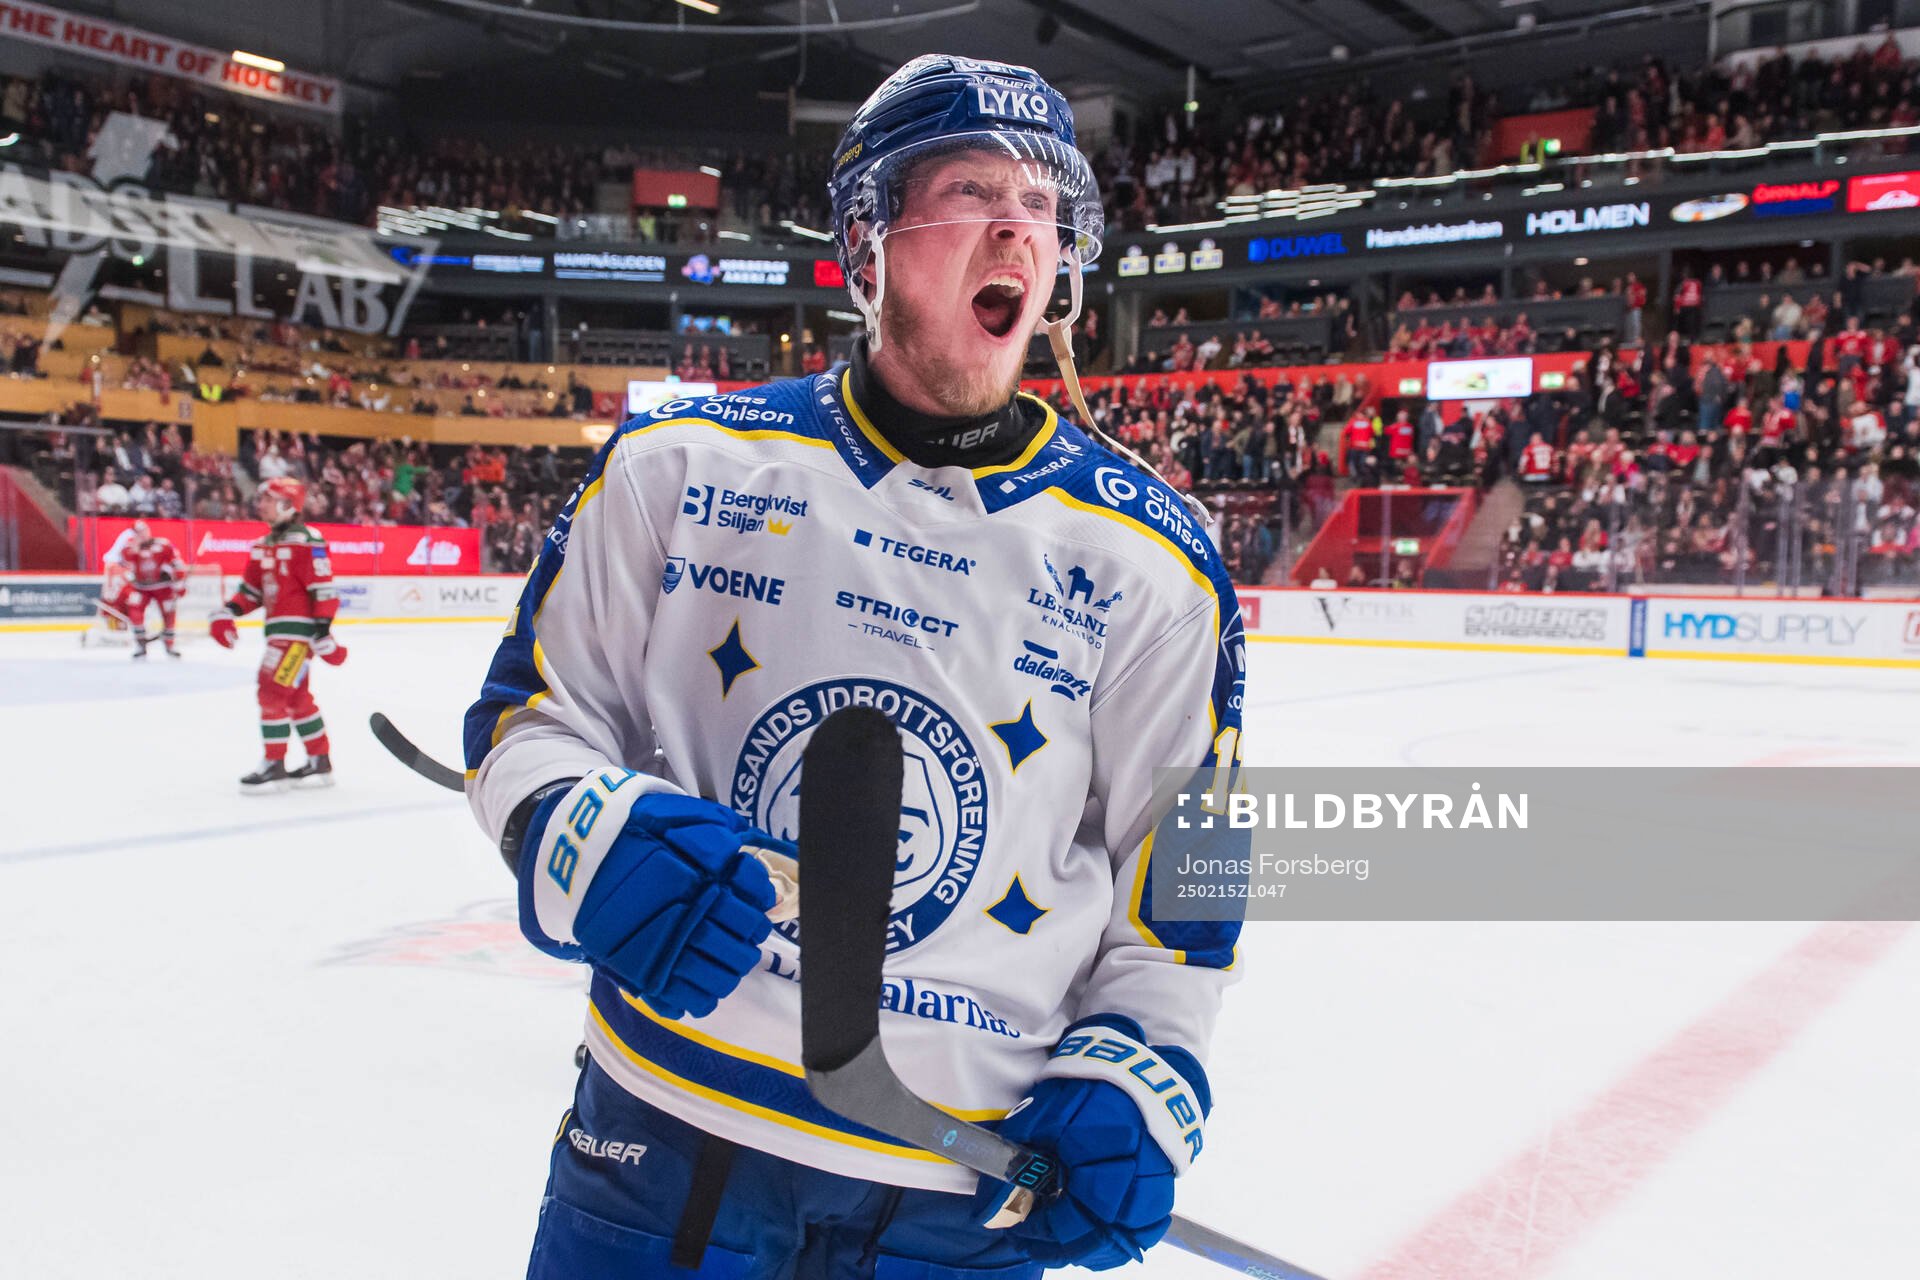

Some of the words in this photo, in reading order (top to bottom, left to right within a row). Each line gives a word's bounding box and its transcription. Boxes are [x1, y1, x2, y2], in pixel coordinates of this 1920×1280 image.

[0, 3, 57, 38] THE
[63, 19, 173, 66] HEART
[176, 50, 217, 77] OF
[221, 60, 335, 106] HOCKEY
[977, 87, 1049, 123] LYKO
[1526, 202, 1651, 237] HOLMEN
[700, 403, 795, 425] Ohlson
[829, 406, 869, 467] TEGERA
[1012, 455, 1074, 484] TEGERA
[720, 489, 808, 517] Bergkvist
[716, 510, 764, 534] Siljan
[1144, 499, 1209, 561] Ohlso
[439, 586, 499, 603] WMC
[688, 563, 786, 606] VOENE
[1663, 611, 1868, 646] HYDSUPPLY
